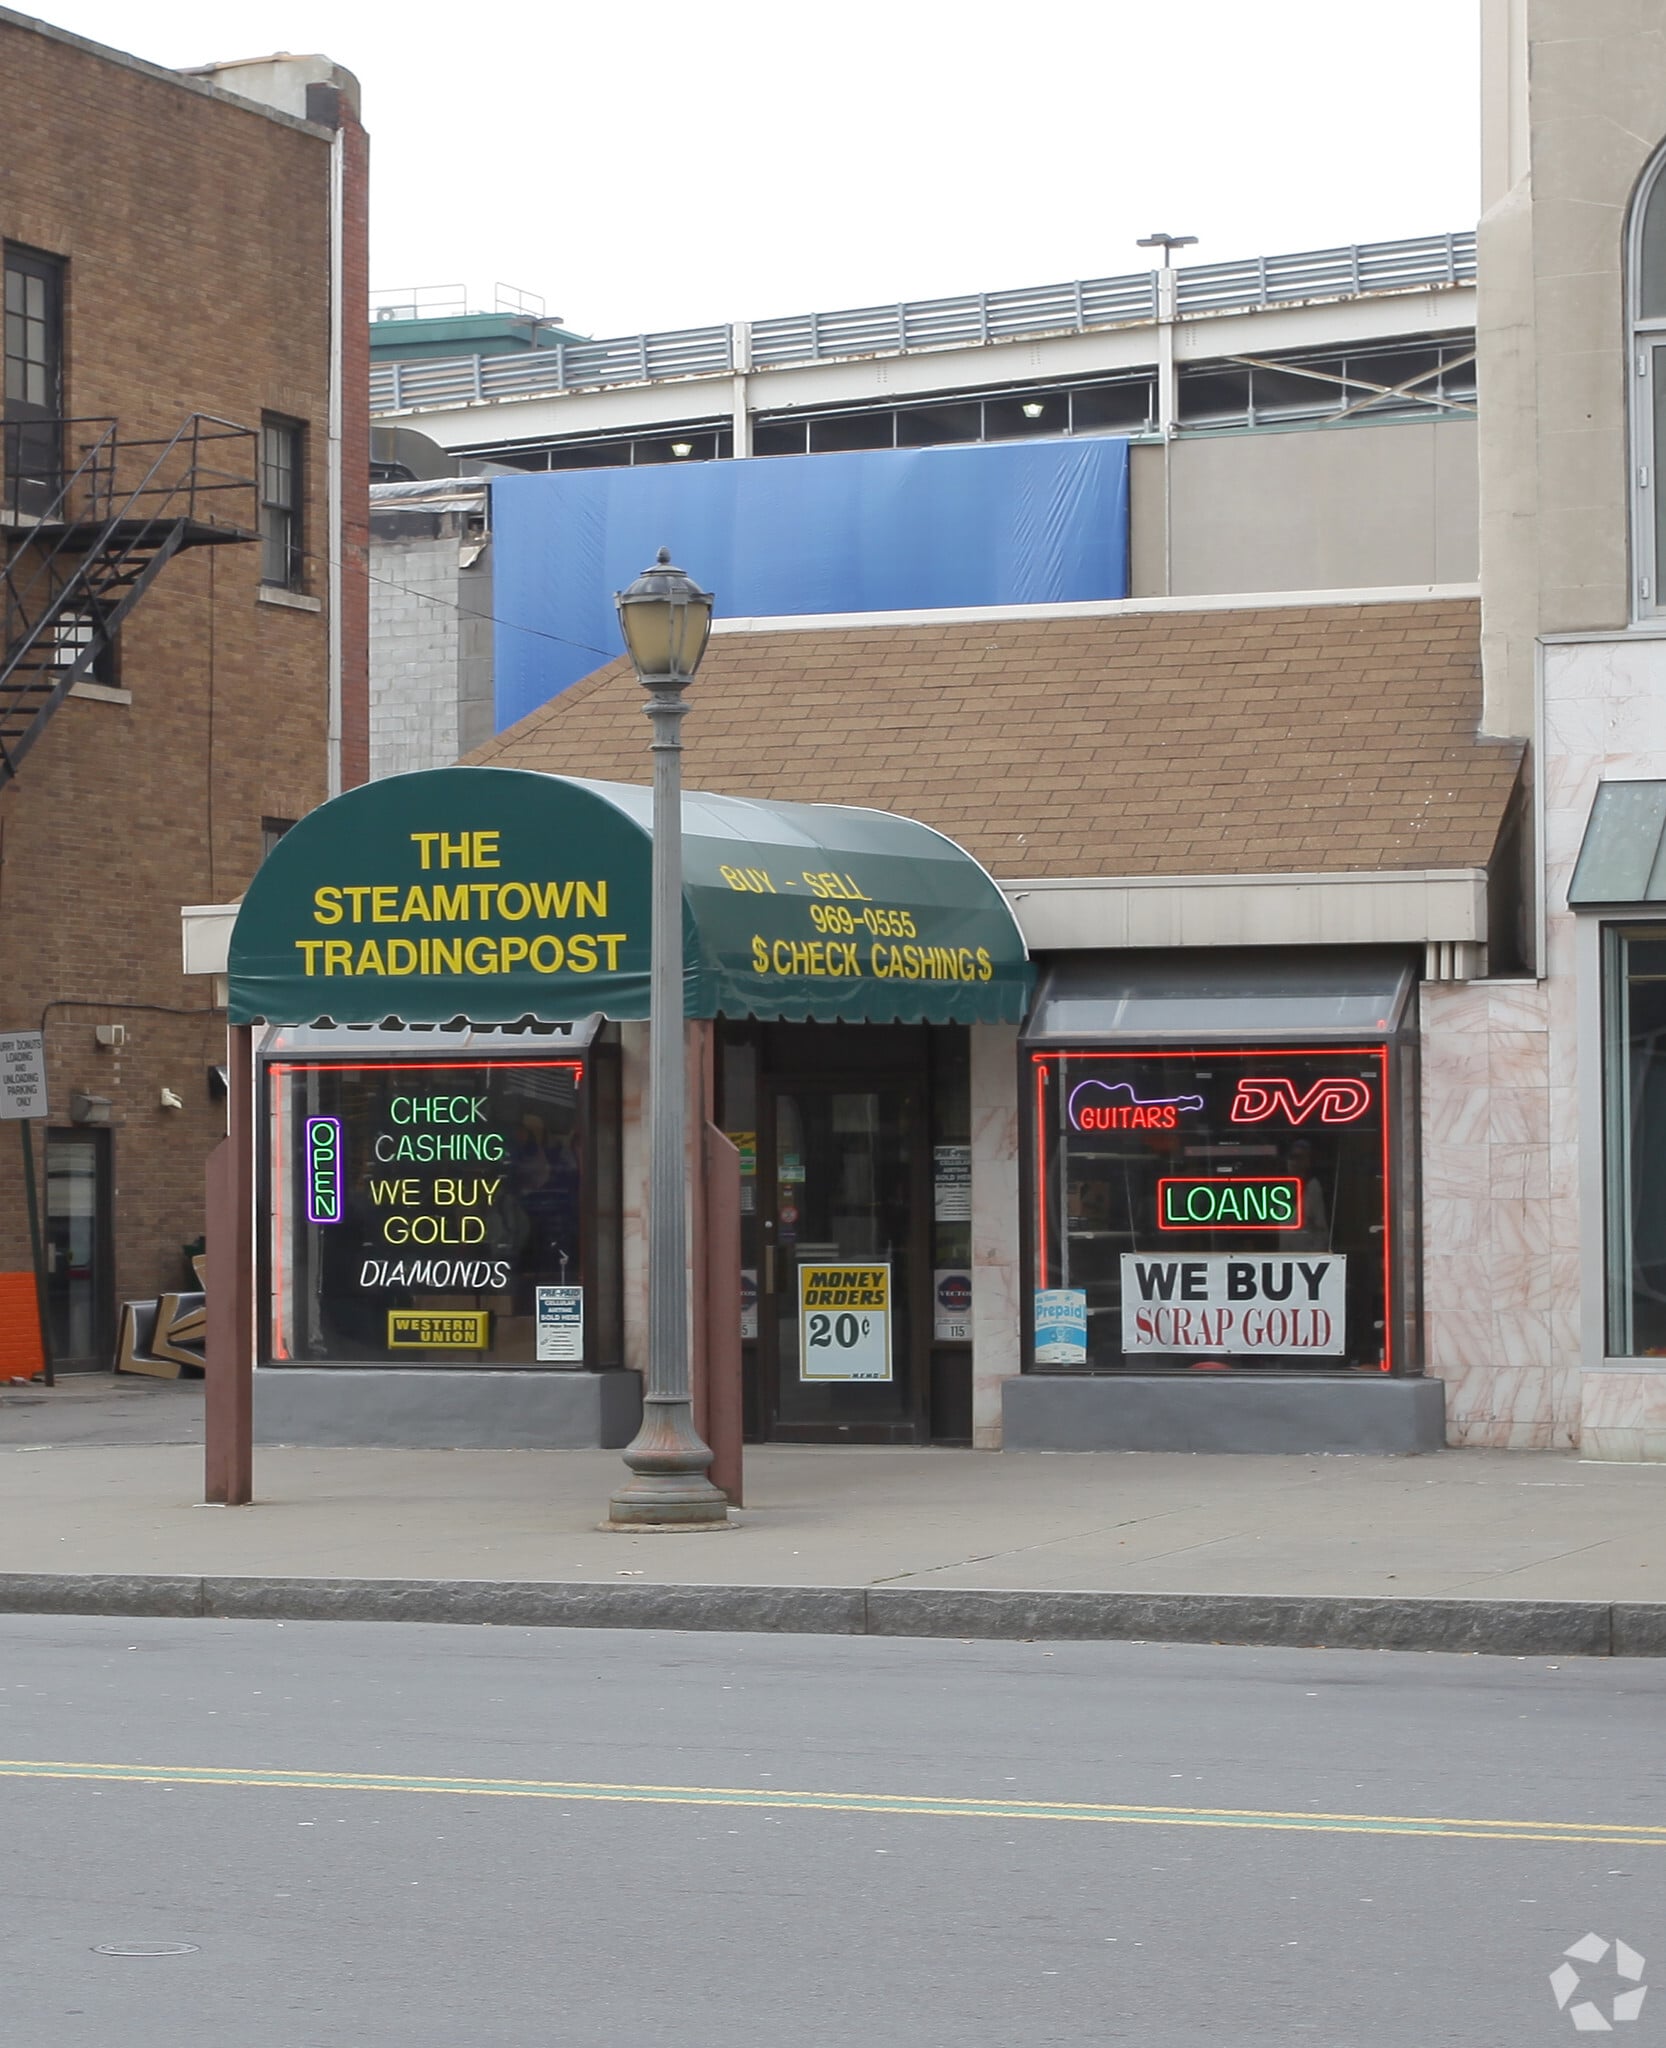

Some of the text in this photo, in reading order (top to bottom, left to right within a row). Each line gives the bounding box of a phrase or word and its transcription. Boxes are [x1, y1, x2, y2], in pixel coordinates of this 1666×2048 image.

[411, 831, 500, 869] THE
[720, 865, 776, 894] BUY
[802, 872, 872, 901] SELL
[313, 881, 608, 924] STEAMTOWN
[810, 904, 917, 938] 969-0555
[295, 934, 627, 977] TRADINGPOST
[871, 944, 992, 984] CASHING$
[6, 1051, 33, 1063] LOADING
[3, 1073, 39, 1085] UNLOADING
[7, 1084, 37, 1096] PARKING
[16, 1096, 31, 1107] ONLY
[391, 1096, 488, 1124] CHECK
[1231, 1078, 1370, 1125] DVD
[1080, 1107, 1177, 1129] GUITARS
[375, 1134, 504, 1162] CASHING
[312, 1123, 335, 1217] OPEN
[370, 1178, 501, 1206] WE BUY
[1166, 1186, 1292, 1221] LOANS
[384, 1215, 486, 1244] GOLD
[360, 1260, 511, 1288] DIAMONDS
[809, 1272, 884, 1288] MONEY
[1135, 1262, 1330, 1301] WE BUY
[805, 1290, 885, 1306] ORDERS
[1036, 1304, 1082, 1320] Prepaid
[396, 1319, 475, 1331] WESTERN
[421, 1331, 475, 1342] UNION
[950, 1325, 965, 1337] 115
[1136, 1307, 1331, 1348] SCRAP GOLD
